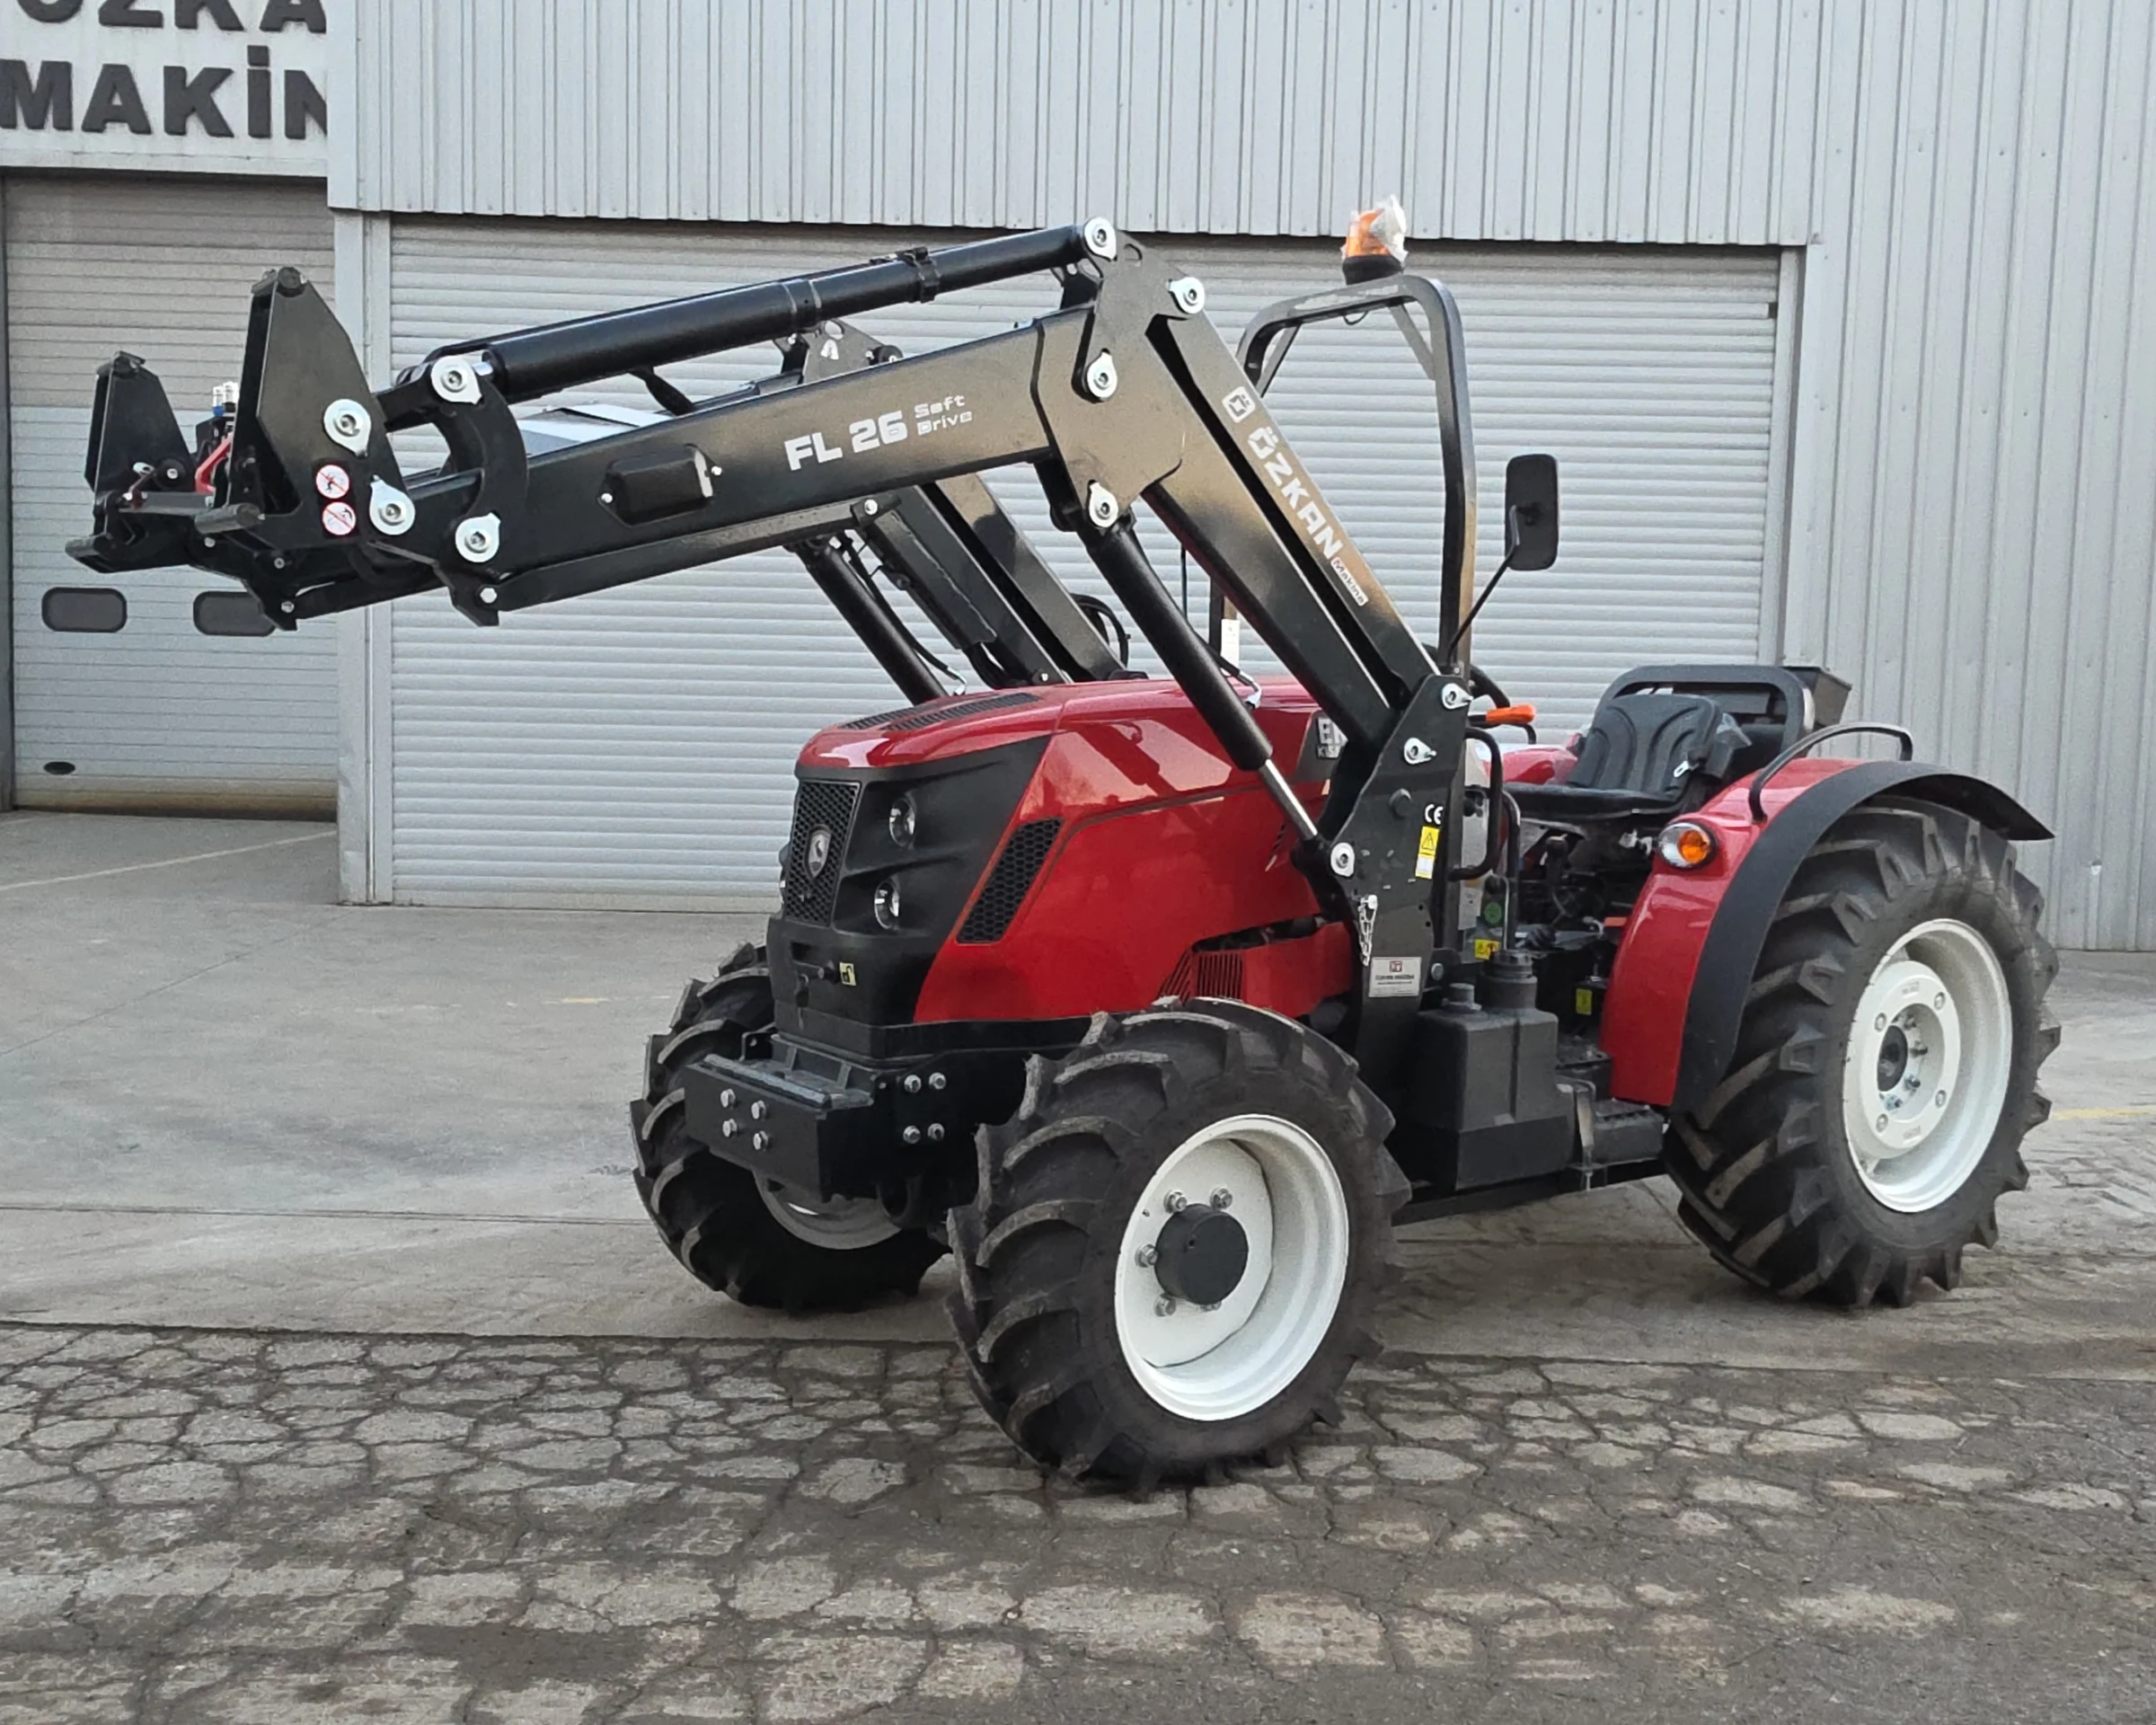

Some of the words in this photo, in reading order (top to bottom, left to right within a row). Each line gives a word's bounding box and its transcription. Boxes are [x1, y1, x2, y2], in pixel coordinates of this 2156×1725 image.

[914, 395, 966, 419] Soft
[916, 411, 973, 436] Drive
[784, 432, 843, 471] FL
[849, 410, 908, 453] 26
[1247, 426, 1343, 560] ÖZKAN
[1425, 803, 1444, 825] CE
